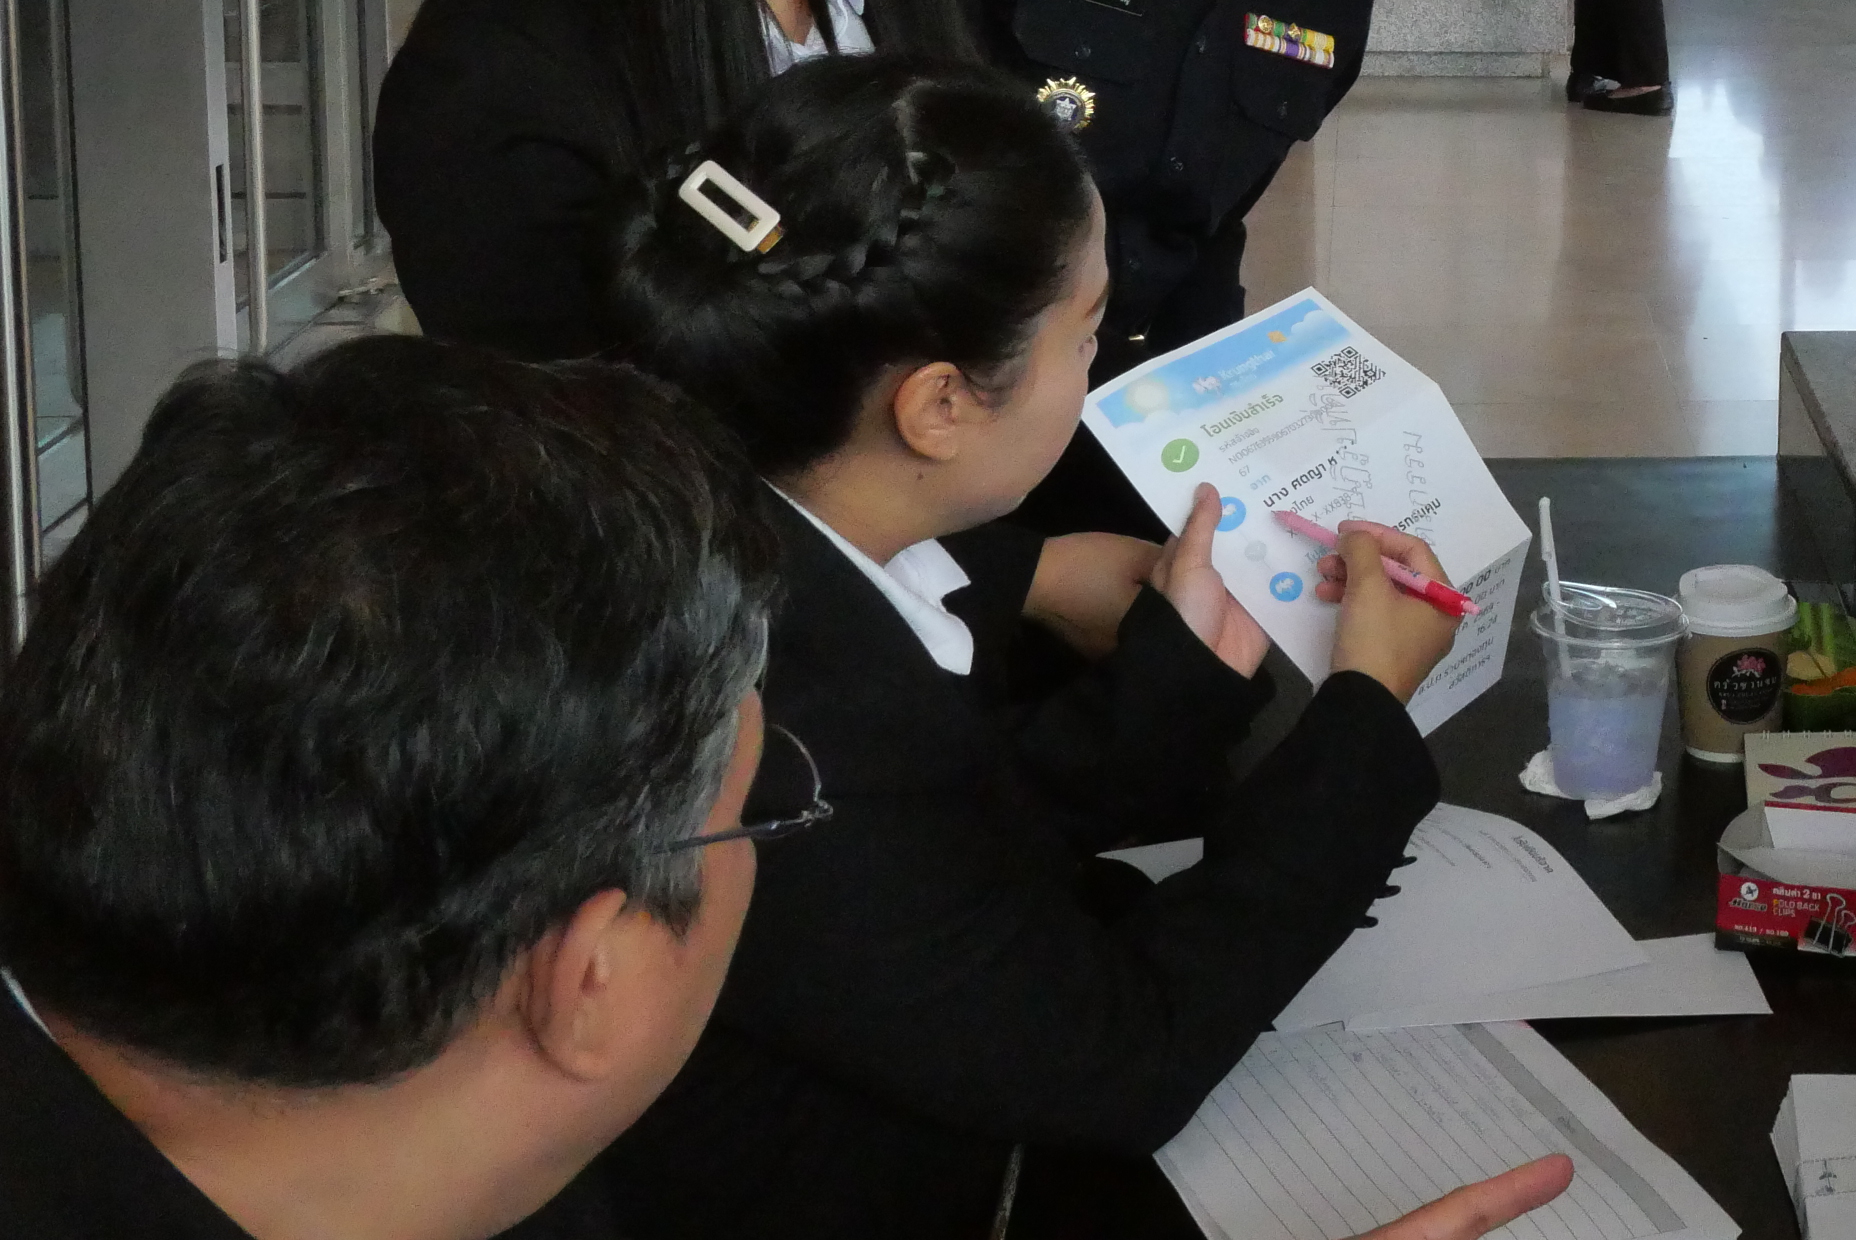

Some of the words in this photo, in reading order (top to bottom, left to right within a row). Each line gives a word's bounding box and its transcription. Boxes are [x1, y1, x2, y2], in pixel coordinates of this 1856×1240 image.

[1218, 349, 1276, 380] Krungthai
[1201, 393, 1284, 438] โอนเงินสำเร็จ
[1263, 488, 1289, 508] นาง
[1803, 889, 1810, 899] 2
